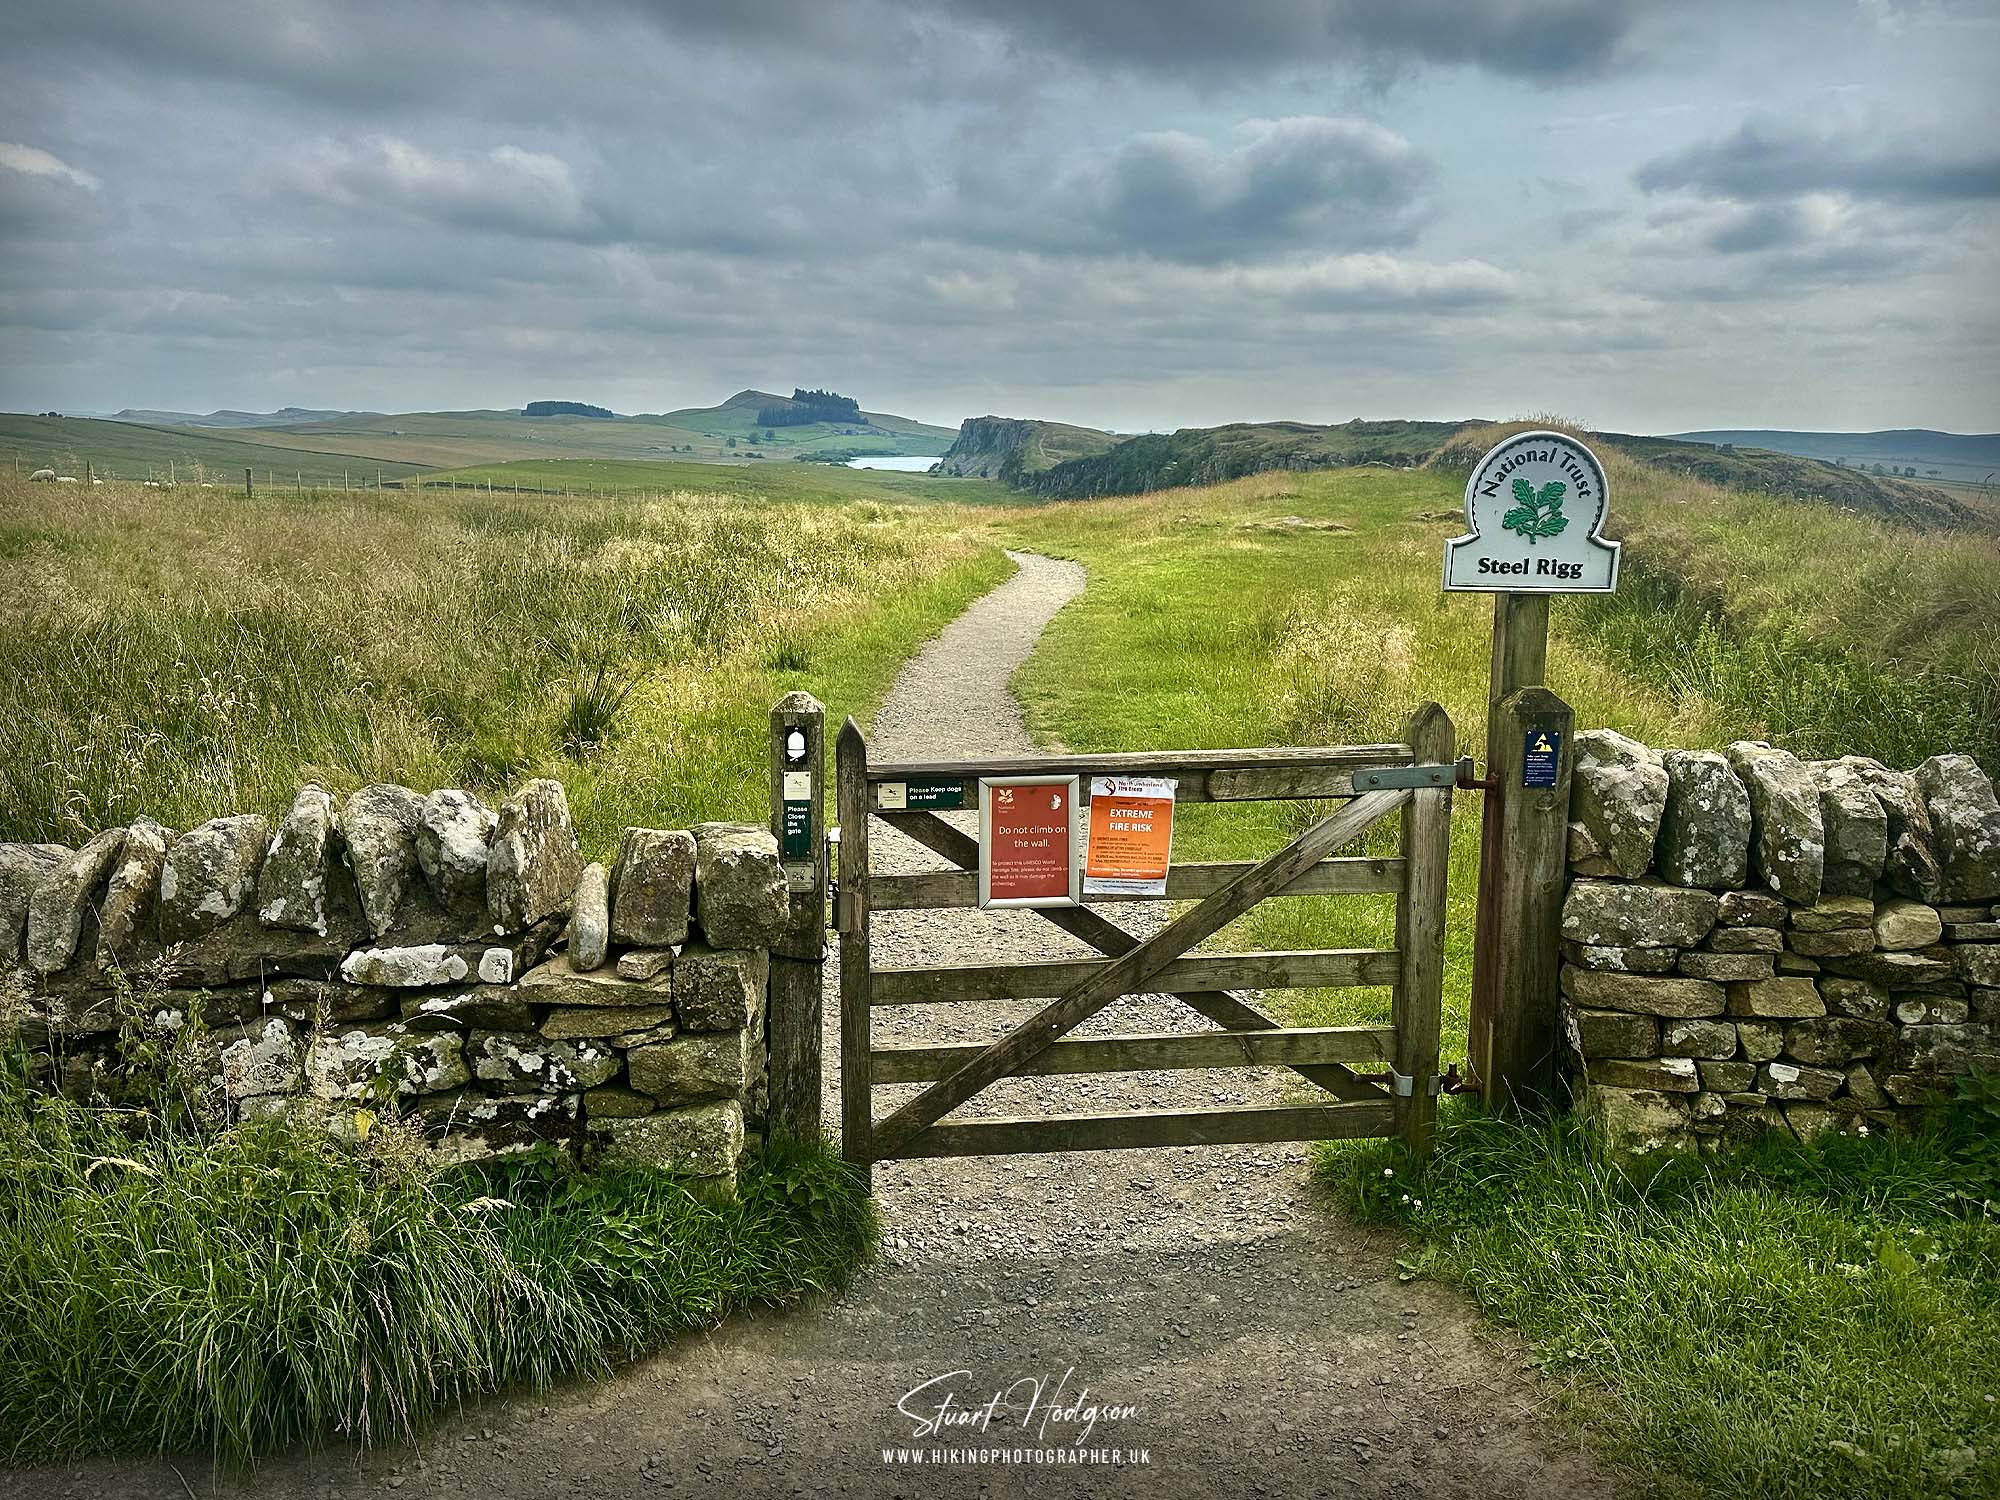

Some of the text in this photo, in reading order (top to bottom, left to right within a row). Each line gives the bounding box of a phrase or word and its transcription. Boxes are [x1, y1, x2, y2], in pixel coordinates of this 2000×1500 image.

[1480, 447, 1592, 499] National Trust
[1477, 557, 1584, 579] Steel Rigg
[1109, 808, 1154, 818] EXTREME
[999, 826, 1011, 834] Do
[1013, 826, 1028, 834] not
[1030, 825, 1053, 834] climb
[1109, 822, 1153, 832] FIRE RISK
[1014, 839, 1050, 848] the wall.
